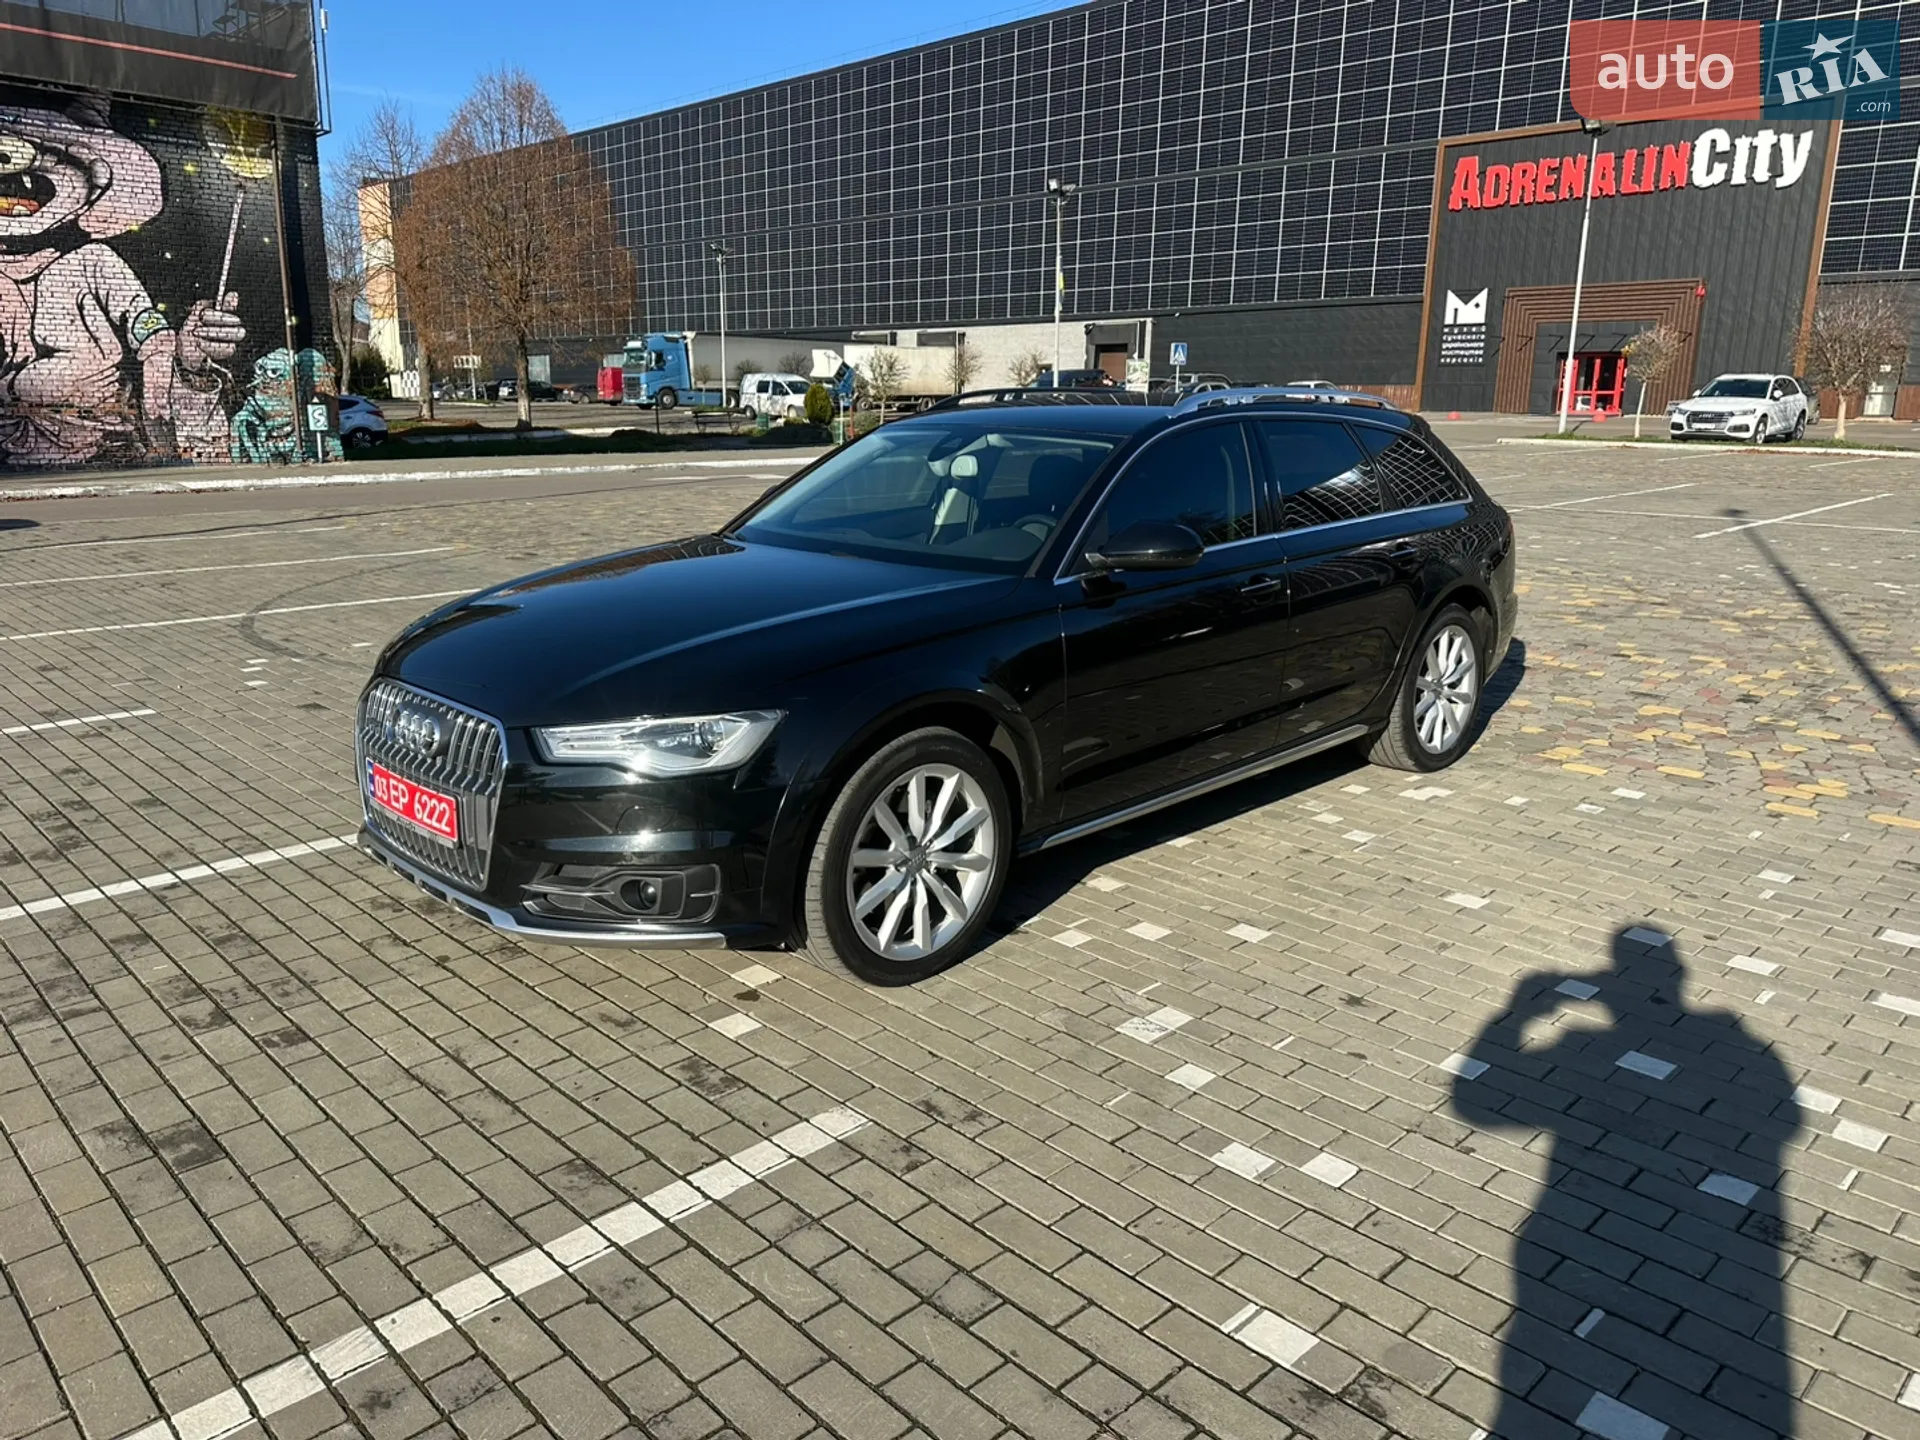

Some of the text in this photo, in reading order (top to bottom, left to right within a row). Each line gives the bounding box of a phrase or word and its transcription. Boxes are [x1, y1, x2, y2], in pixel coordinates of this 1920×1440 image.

[374, 774, 388, 801] 03
[389, 778, 409, 811] EP
[414, 791, 452, 833] 6222
